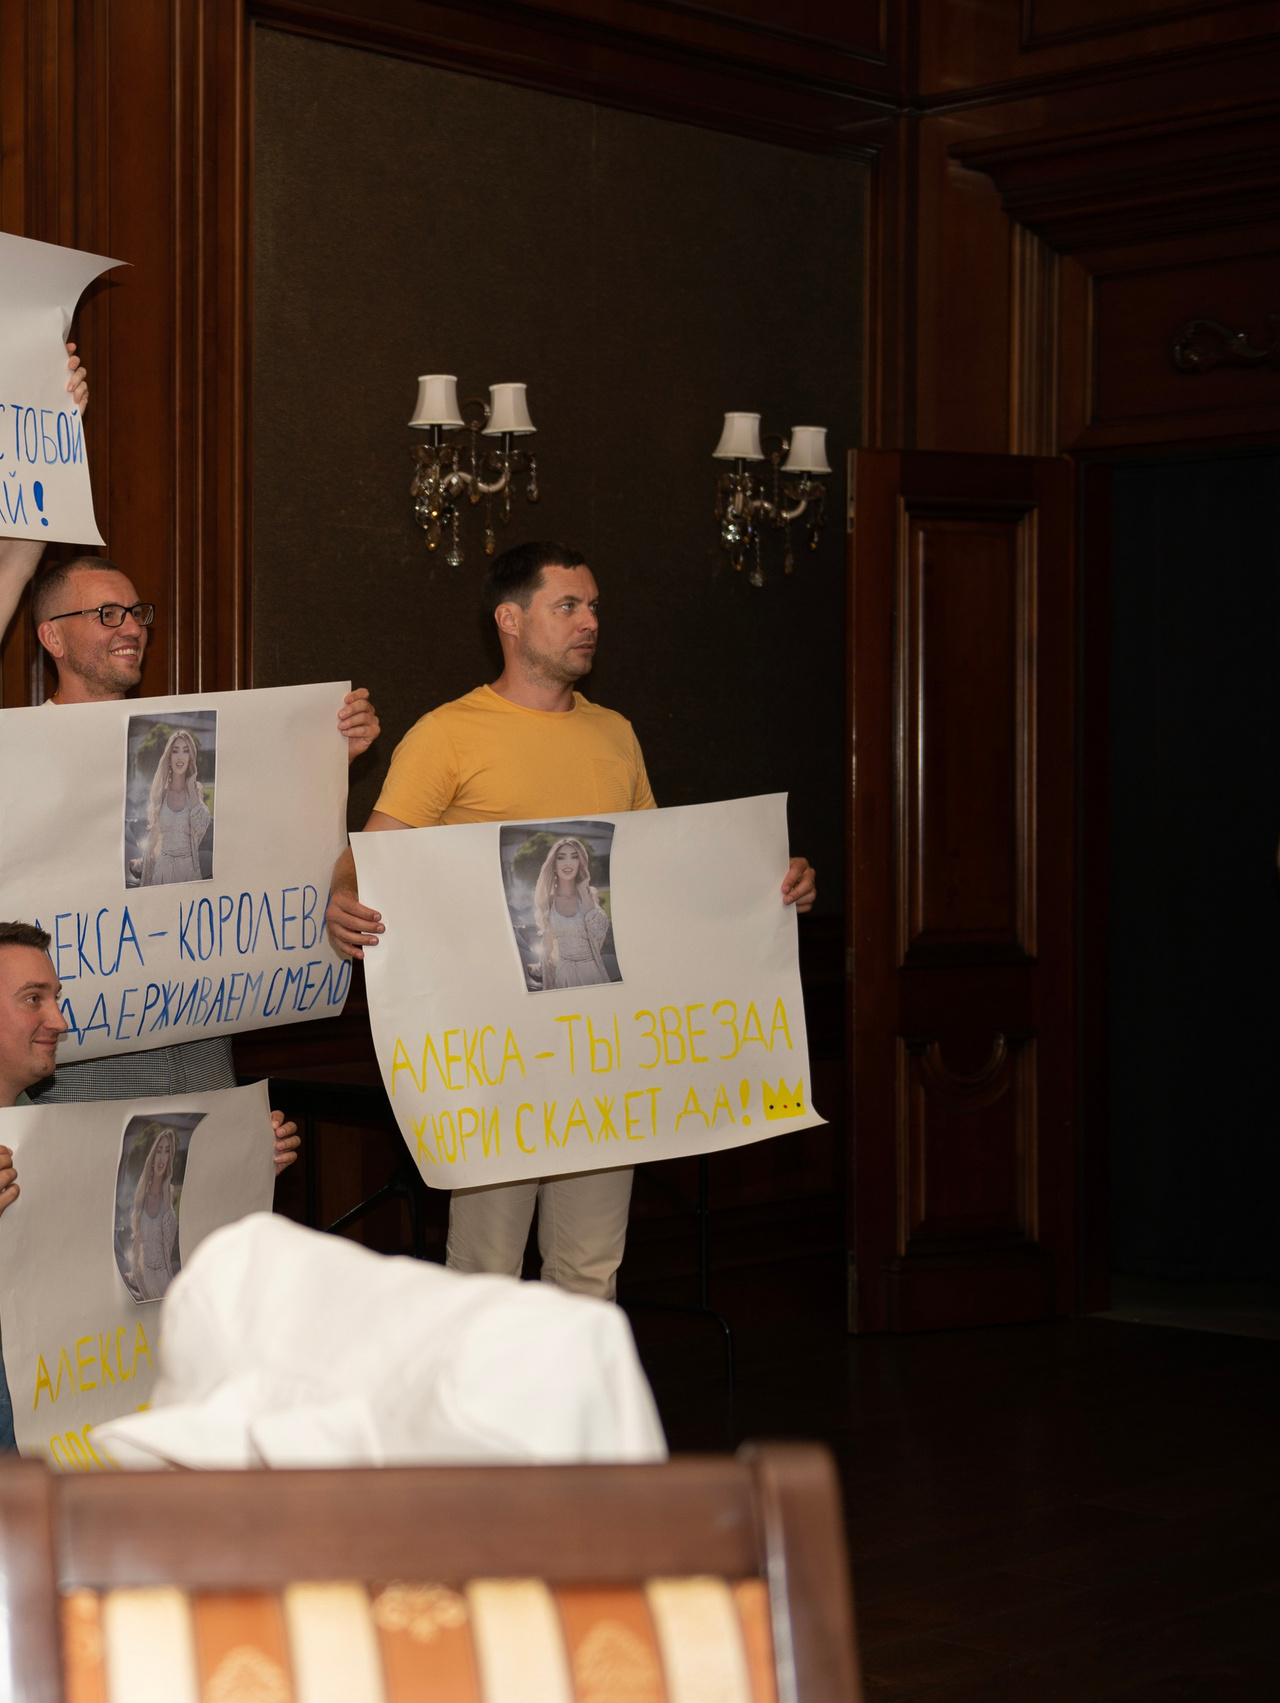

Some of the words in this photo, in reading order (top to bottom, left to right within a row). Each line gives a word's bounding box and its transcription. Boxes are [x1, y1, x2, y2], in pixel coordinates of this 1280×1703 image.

[391, 1025, 526, 1096] АЛЕКСА
[554, 1013, 621, 1076] ТЫ
[634, 997, 793, 1070] ЗВЕЗДА
[405, 1105, 500, 1166] ЖЮРИ
[515, 1086, 663, 1154] СКАЖЕТ
[675, 1078, 752, 1133] ДА!
[33, 1322, 154, 1411] АЛЕКСА
